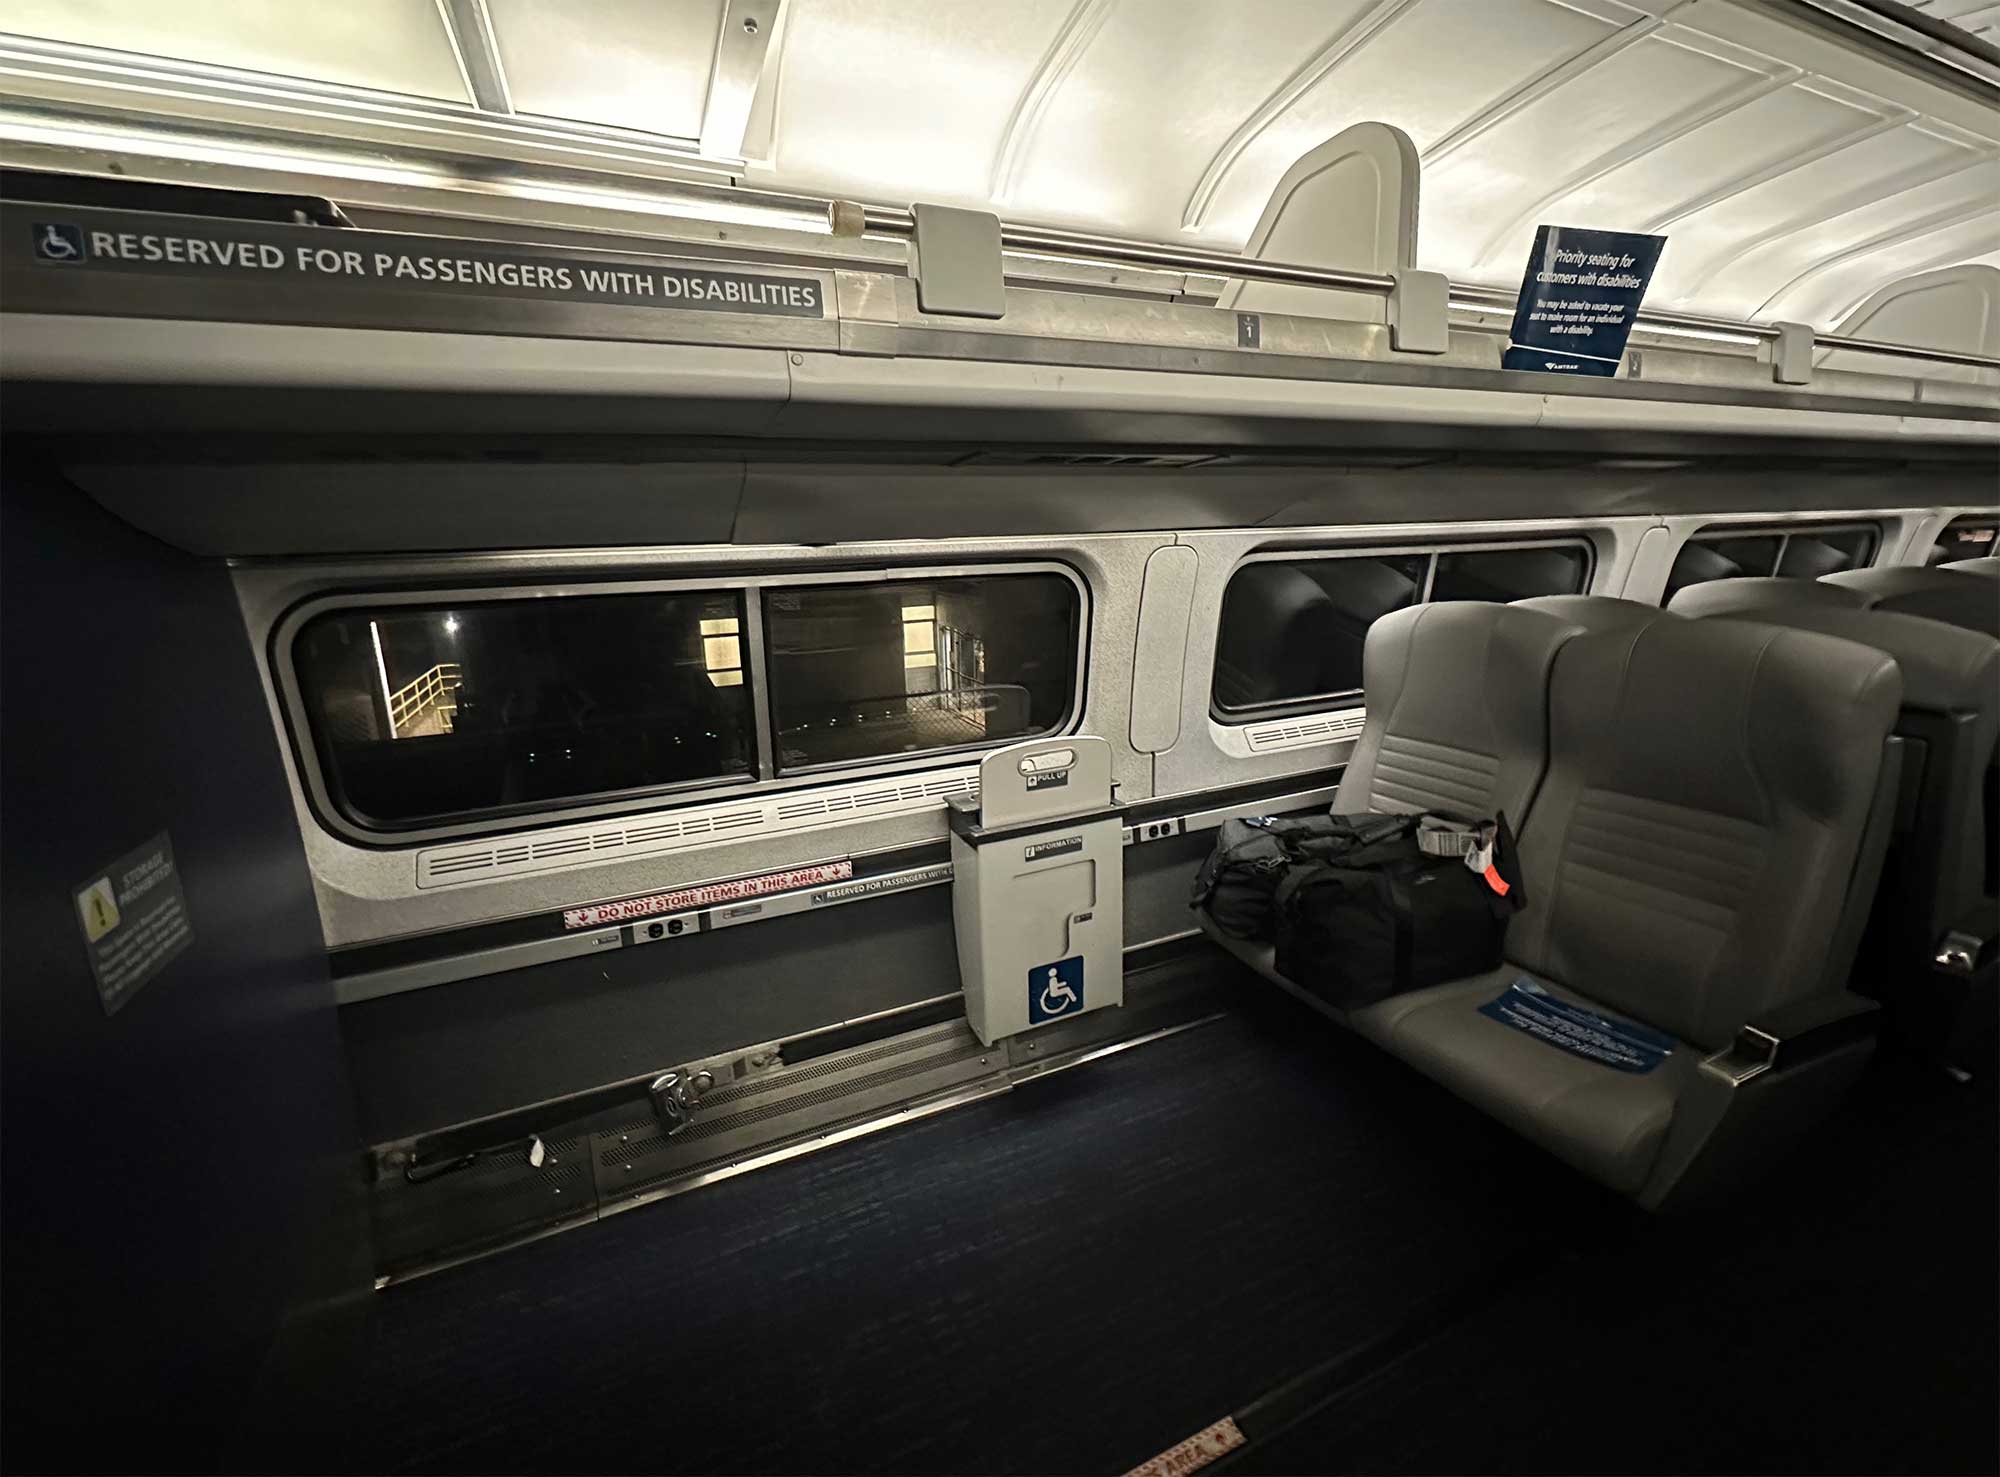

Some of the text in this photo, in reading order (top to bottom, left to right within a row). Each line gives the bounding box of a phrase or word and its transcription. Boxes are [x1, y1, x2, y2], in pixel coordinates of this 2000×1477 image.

[1554, 249, 1636, 270] Priority seating for
[91, 231, 816, 308] RESERVED FOR PASSENGERS WITH DISABILITIES
[1536, 272, 1642, 289] customers with disabilities
[1546, 301, 1560, 311] may
[1559, 300, 1568, 309] be
[1608, 304, 1625, 313] your
[1246, 326, 1252, 338] 1
[1037, 771, 1067, 782] PULL UP
[1035, 838, 1082, 851] INFORMATION
[826, 885, 865, 899] RESERVED
[865, 880, 882, 891] FOR
[882, 874, 928, 888] PASSENGERS
[598, 871, 824, 920] DO NOT STORE ITEMS IN THIS AREA
